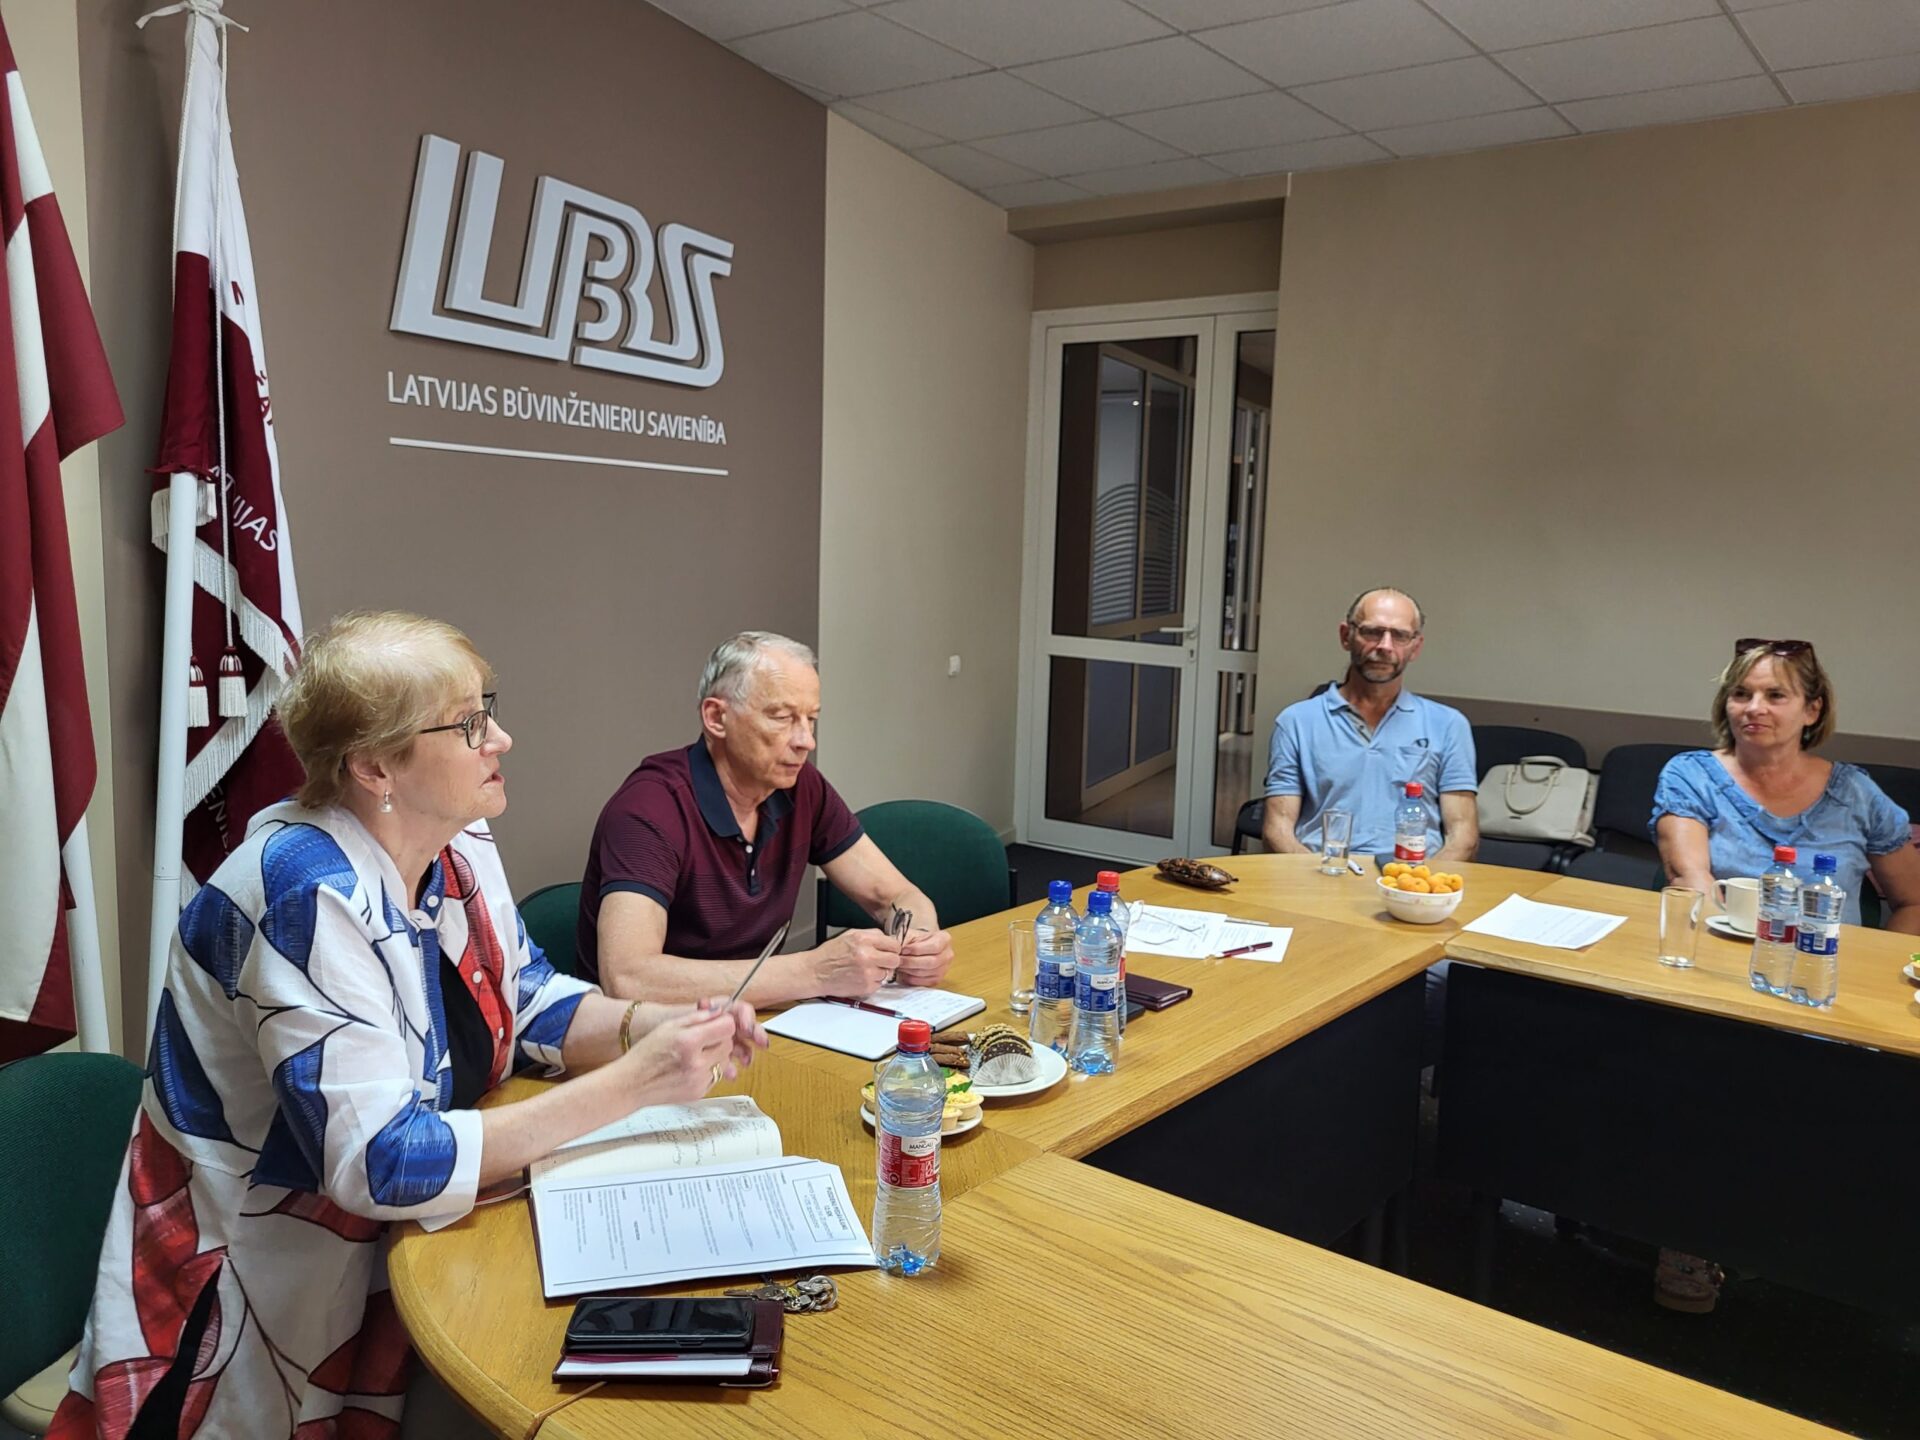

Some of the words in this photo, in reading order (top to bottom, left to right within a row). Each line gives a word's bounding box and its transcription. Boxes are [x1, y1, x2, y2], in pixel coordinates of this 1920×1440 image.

[390, 133, 734, 388] LBS
[388, 371, 498, 415] LATVIJAS
[503, 386, 645, 435] BŪVINŽENIERU
[648, 411, 727, 445] SAVIENĪBA
